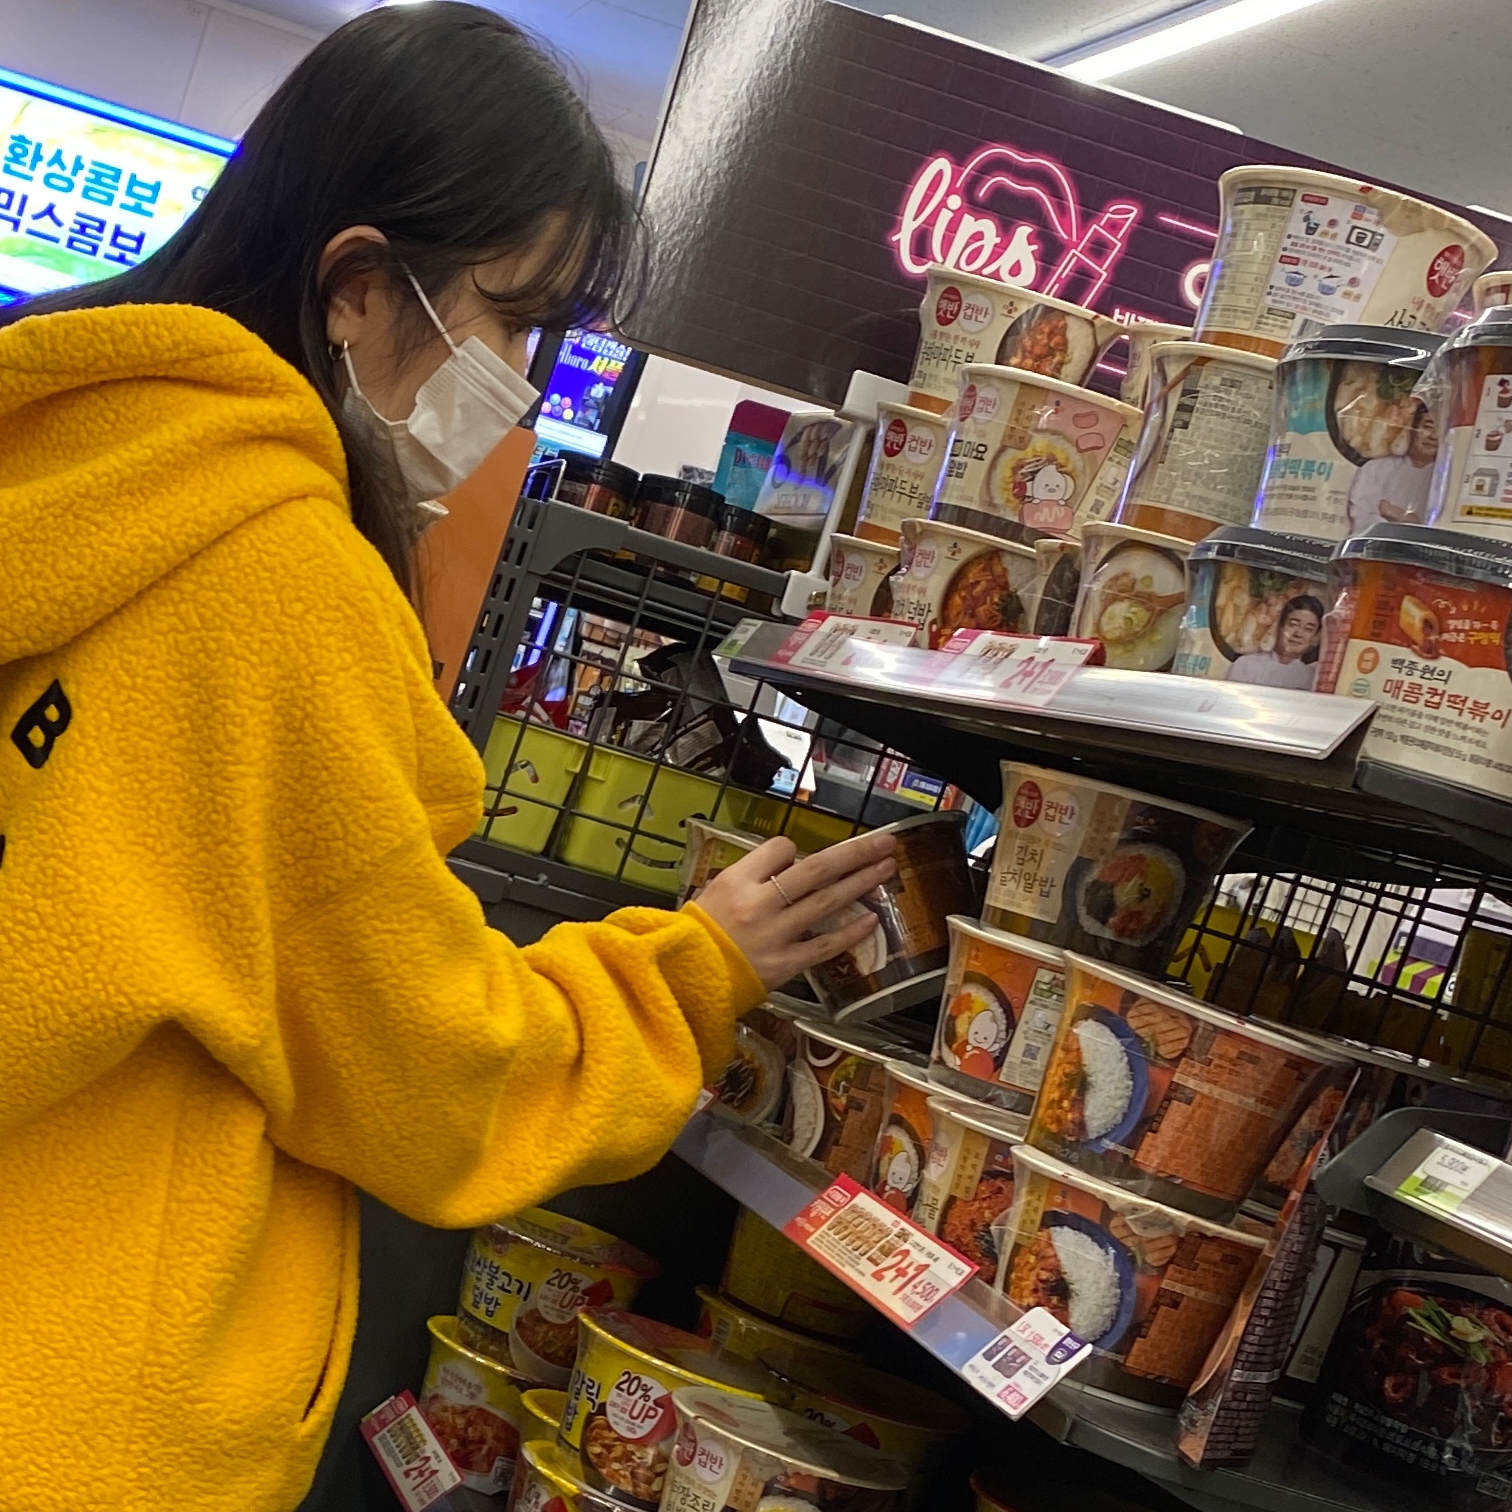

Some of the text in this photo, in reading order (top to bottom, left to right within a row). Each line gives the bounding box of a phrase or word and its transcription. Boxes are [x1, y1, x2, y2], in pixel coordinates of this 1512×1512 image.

[0, 133, 163, 219] 환상콤보
[892, 157, 1039, 287] lips
[962, 302, 990, 324] 컵반
[907, 435, 933, 457] 컵반
[1389, 657, 1453, 685] 백종원의
[1382, 678, 1512, 729] 매콤컵떡볶이
[1043, 799, 1076, 826] 컵반
[1016, 845, 1044, 871] 김치
[546, 1268, 582, 1294] 20%
[871, 1249, 931, 1296] 2+1
[558, 1290, 586, 1311] UP
[615, 1370, 655, 1403] 20%
[628, 1402, 659, 1425] UP
[696, 1443, 725, 1475] 컵반
[403, 1455, 440, 1492] 2+1
